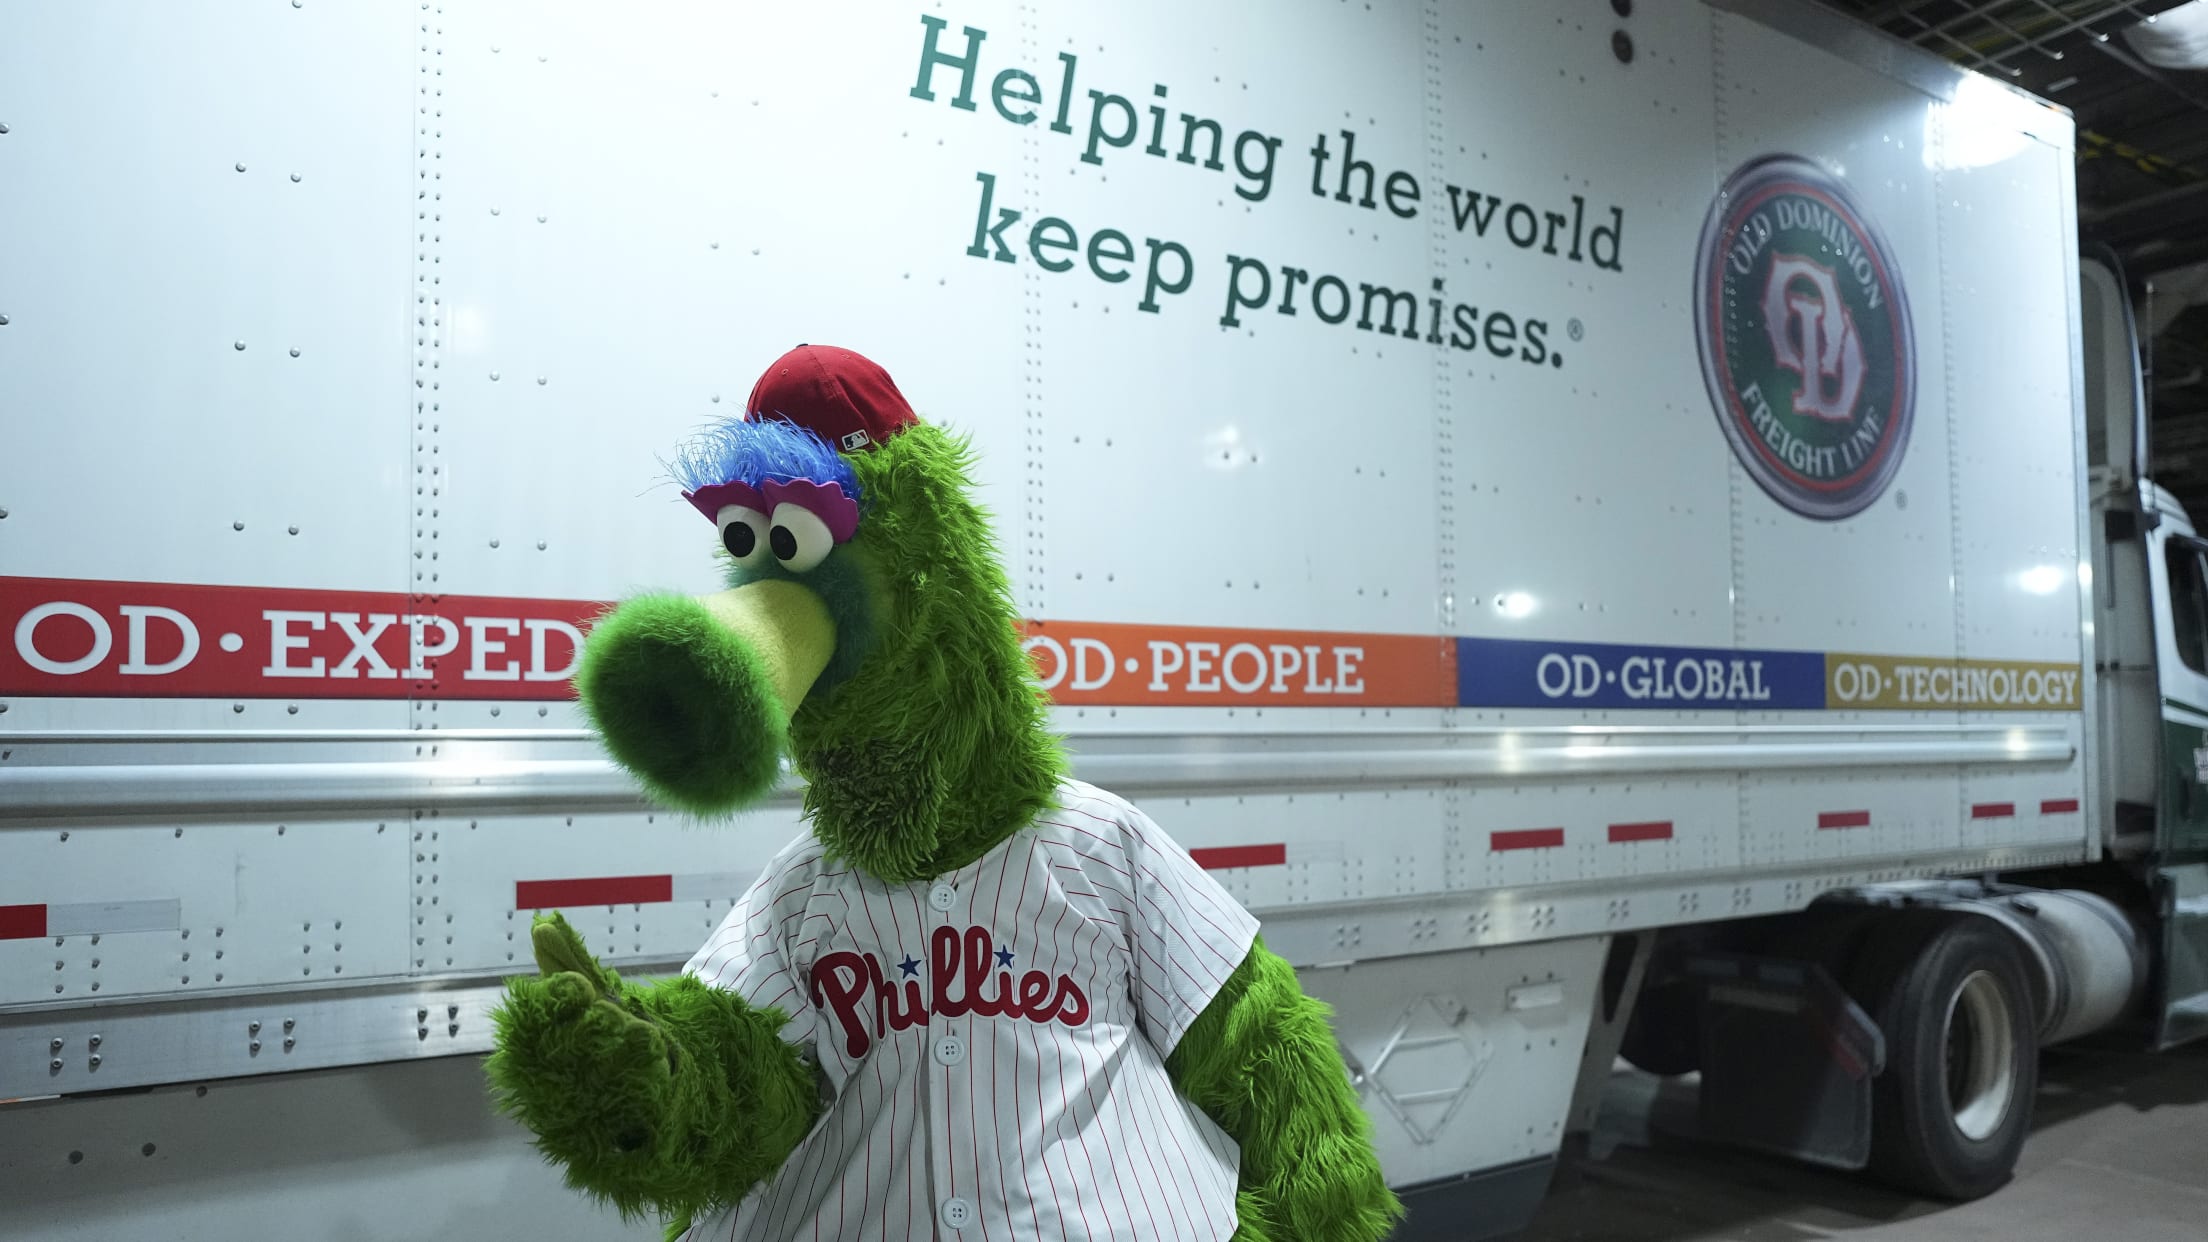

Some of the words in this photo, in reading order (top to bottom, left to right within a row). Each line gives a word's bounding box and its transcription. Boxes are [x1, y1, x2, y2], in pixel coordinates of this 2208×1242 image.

[909, 14, 1282, 201] Helping
[1310, 130, 1421, 219] the
[1446, 185, 1623, 272] world
[966, 172, 1193, 313] keep
[1733, 212, 1772, 275] OLD
[1775, 199, 1882, 309] DOMINION
[1742, 381, 1835, 477] FREIGHT
[1840, 405, 1881, 469] LINE
[14, 601, 602, 681] OD·EXPED
[811, 925, 1090, 1058] Phillies
